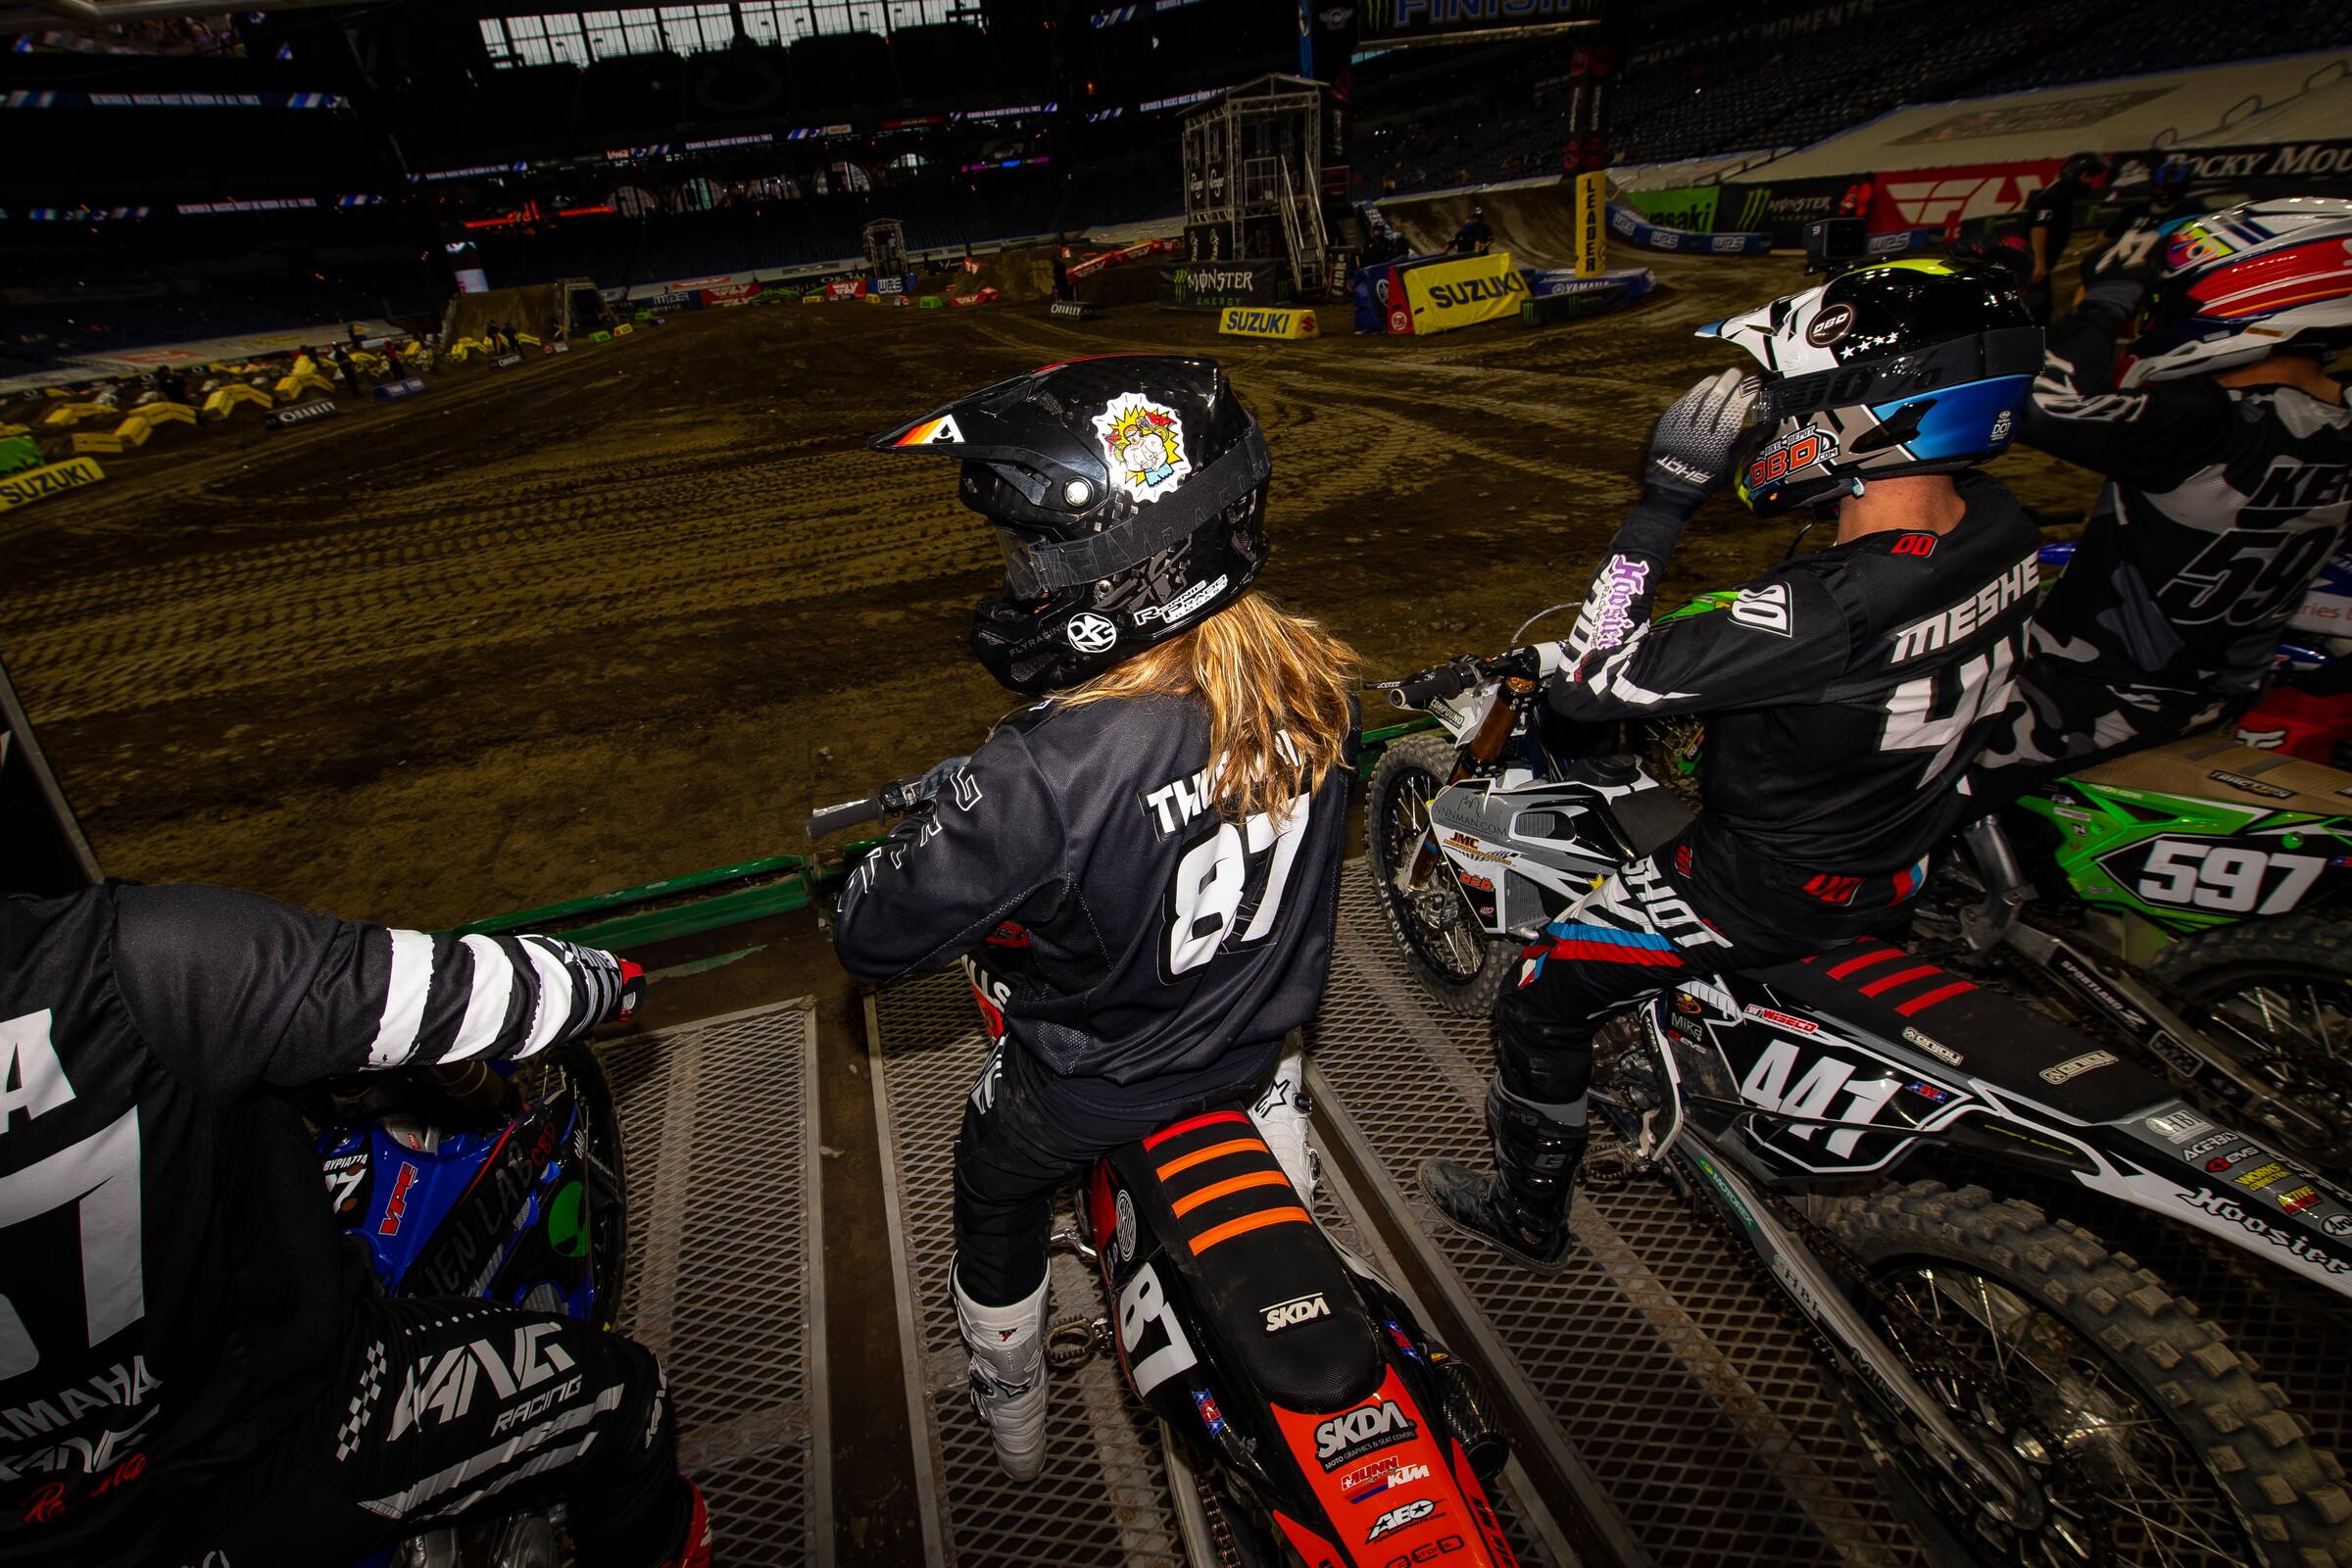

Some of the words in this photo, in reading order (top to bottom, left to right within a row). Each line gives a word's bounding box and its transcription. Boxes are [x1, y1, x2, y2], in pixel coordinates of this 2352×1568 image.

[1586, 179, 1597, 272] LEADER
[1712, 235, 1746, 253] WPS
[1868, 231, 1911, 252] WPS
[1187, 269, 1254, 294] MONSTER
[1428, 273, 1525, 309] SUZUKI
[1227, 311, 1291, 334] SUZUKI
[278, 400, 337, 424] OAKLEY
[1788, 426, 1815, 444] DEPOT
[1992, 422, 2012, 435] DOT
[1748, 436, 1820, 490] DBD
[0, 463, 95, 505] SUZUKI
[1430, 698, 1465, 726] COMPOUND
[1449, 831, 1480, 850] JMC
[1169, 791, 1311, 977] 87
[2136, 839, 2329, 915] 597
[1671, 1011, 1703, 1039] Mika
[1740, 1038, 1904, 1160] 441
[1904, 1081, 1948, 1103] AMA
[530, 1119, 558, 1171] CBD
[2232, 1162, 2282, 1186] WORKS
[1712, 1172, 1754, 1227] MOTOREX
[2276, 1184, 2316, 1209] ACTIVE
[1264, 1299, 1332, 1333] SKDA
[489, 1373, 583, 1438] RACING
[1315, 1401, 1409, 1459] SKDA
[1324, 1455, 1345, 1471] MOTO
[1344, 1443, 1373, 1460] GRAPHICS
[1378, 1436, 1393, 1446] SEAT
[1392, 1430, 1415, 1442] COVERS
[1342, 1455, 1399, 1492] MUNN
[1387, 1463, 1431, 1489] KTM
